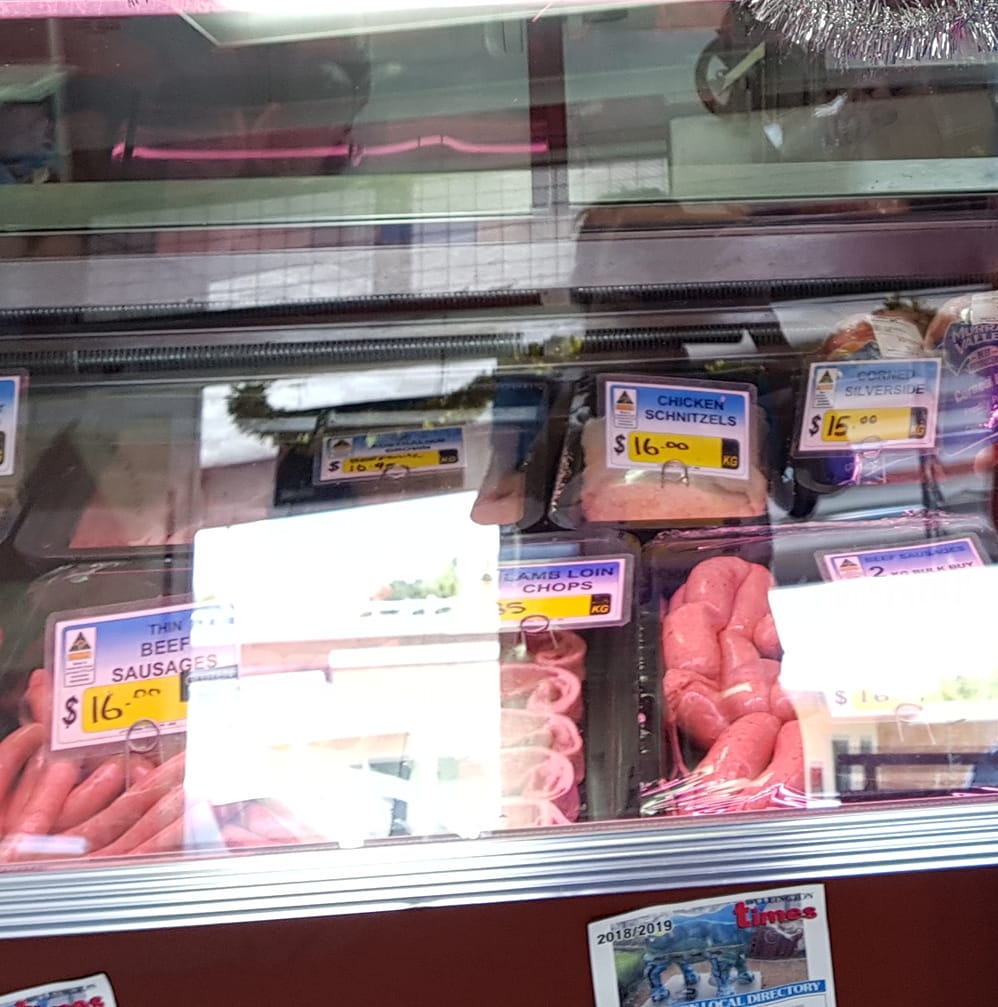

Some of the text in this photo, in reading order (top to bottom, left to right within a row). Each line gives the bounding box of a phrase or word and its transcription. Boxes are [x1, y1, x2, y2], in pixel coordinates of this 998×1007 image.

[844, 383, 926, 397] SILVERSIDE
[657, 395, 725, 411] CHICKEN
[645, 409, 737, 427] SCHNITZELS
[809, 414, 822, 437] $
[614, 434, 626, 456] $
[723, 455, 738, 467] KG
[504, 567, 614, 582] LAMB LOIN
[522, 581, 593, 594] CHOPS
[591, 604, 609, 613] KG
[150, 620, 183, 635] THIN
[141, 637, 190, 657] BEEF
[112, 653, 218, 683] SAUSAGES
[62, 695, 79, 728] $
[733, 901, 818, 929] times
[597, 919, 673, 945] 2018/2019
[702, 981, 821, 1007] LOCAL DIRECTORY
